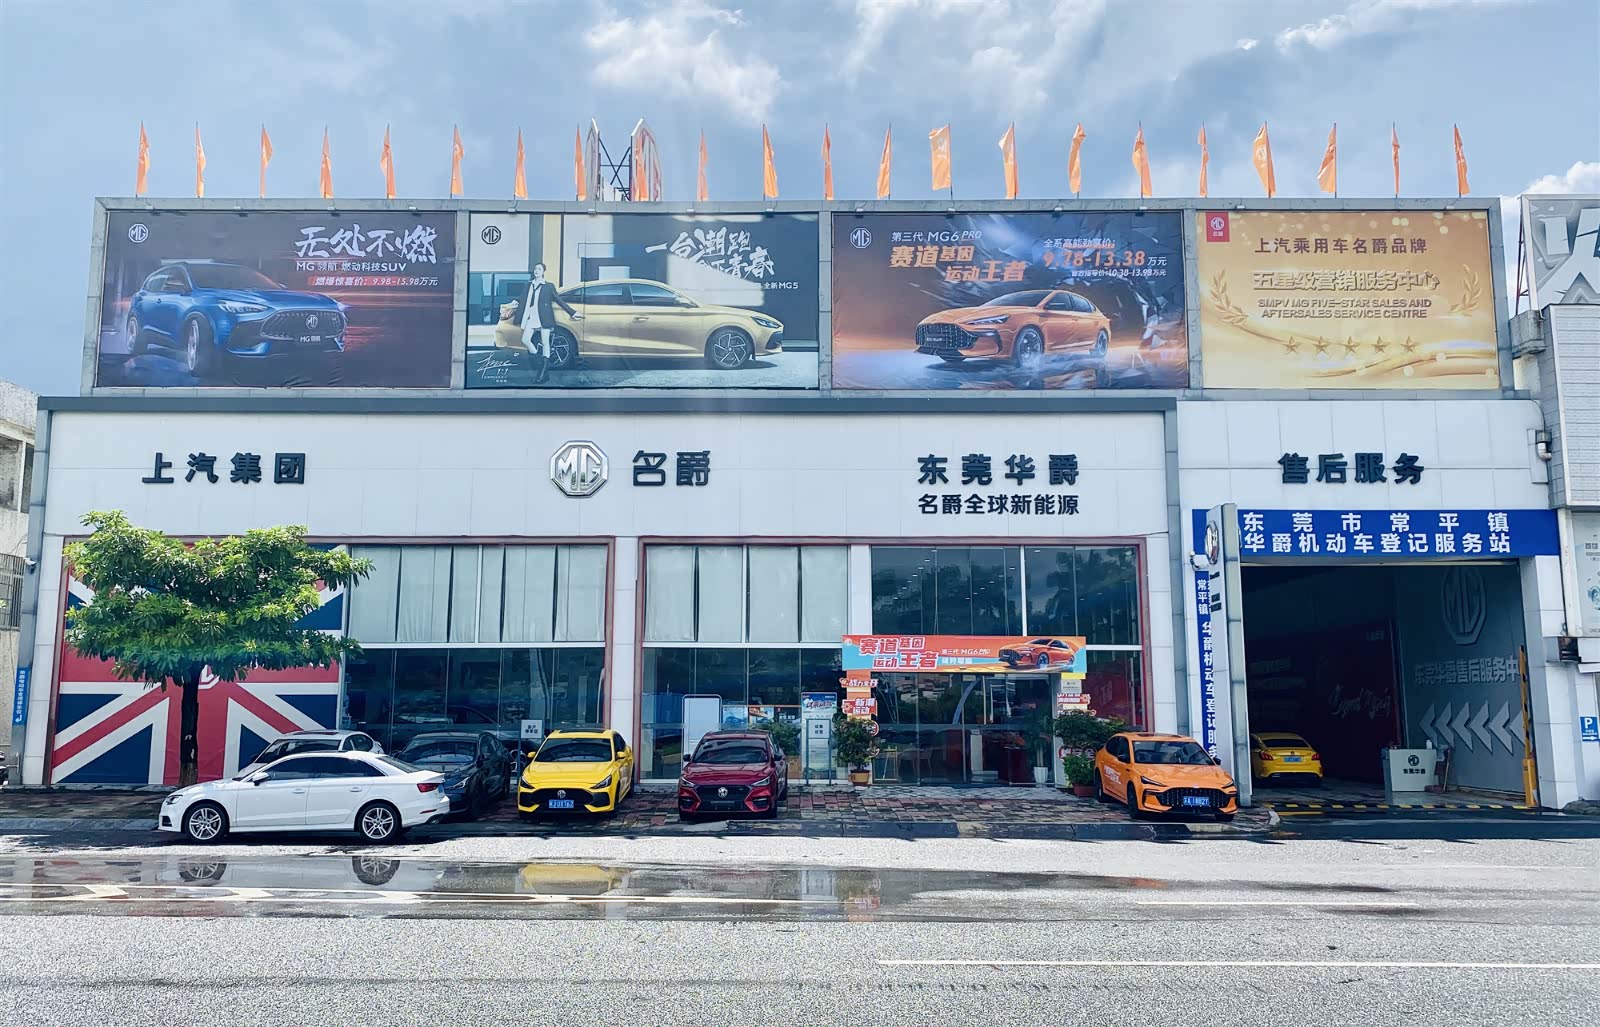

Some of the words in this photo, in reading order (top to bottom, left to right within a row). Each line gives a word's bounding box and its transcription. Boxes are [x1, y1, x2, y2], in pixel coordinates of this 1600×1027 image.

[129, 224, 148, 242] MG
[481, 226, 501, 244] MG
[850, 228, 872, 249] MG
[891, 232, 923, 242] 第三代
[927, 232, 959, 242] MG6
[961, 230, 982, 239] PRO
[1254, 237, 1428, 254] 上汽乘用车名爵品牌
[296, 262, 315, 271] MG
[888, 245, 975, 268] 赛道基因
[944, 260, 1028, 282] 运动王者
[1252, 269, 1441, 291] 五星级营销服务中心
[1261, 309, 1333, 318] AFTERSALES
[1334, 309, 1382, 318] SERVICE
[1383, 309, 1428, 318] CENTRE
[1372, 299, 1407, 308] SALES
[1408, 299, 1432, 308] AND
[142, 452, 306, 485] 上汽集团
[552, 441, 608, 497] MG
[632, 450, 711, 486] 名爵
[917, 454, 1079, 486] 东莞华爵
[1277, 452, 1425, 485] 售后服务
[918, 493, 1080, 516] 名爵全球新能源
[1243, 512, 1510, 533] 东莞市常平镇
[1244, 533, 1511, 553] 华爵机动车登记服务站
[860, 636, 925, 656] 赛道基因
[872, 651, 939, 669] 运动王者
[1584, 717, 1593, 729] P
